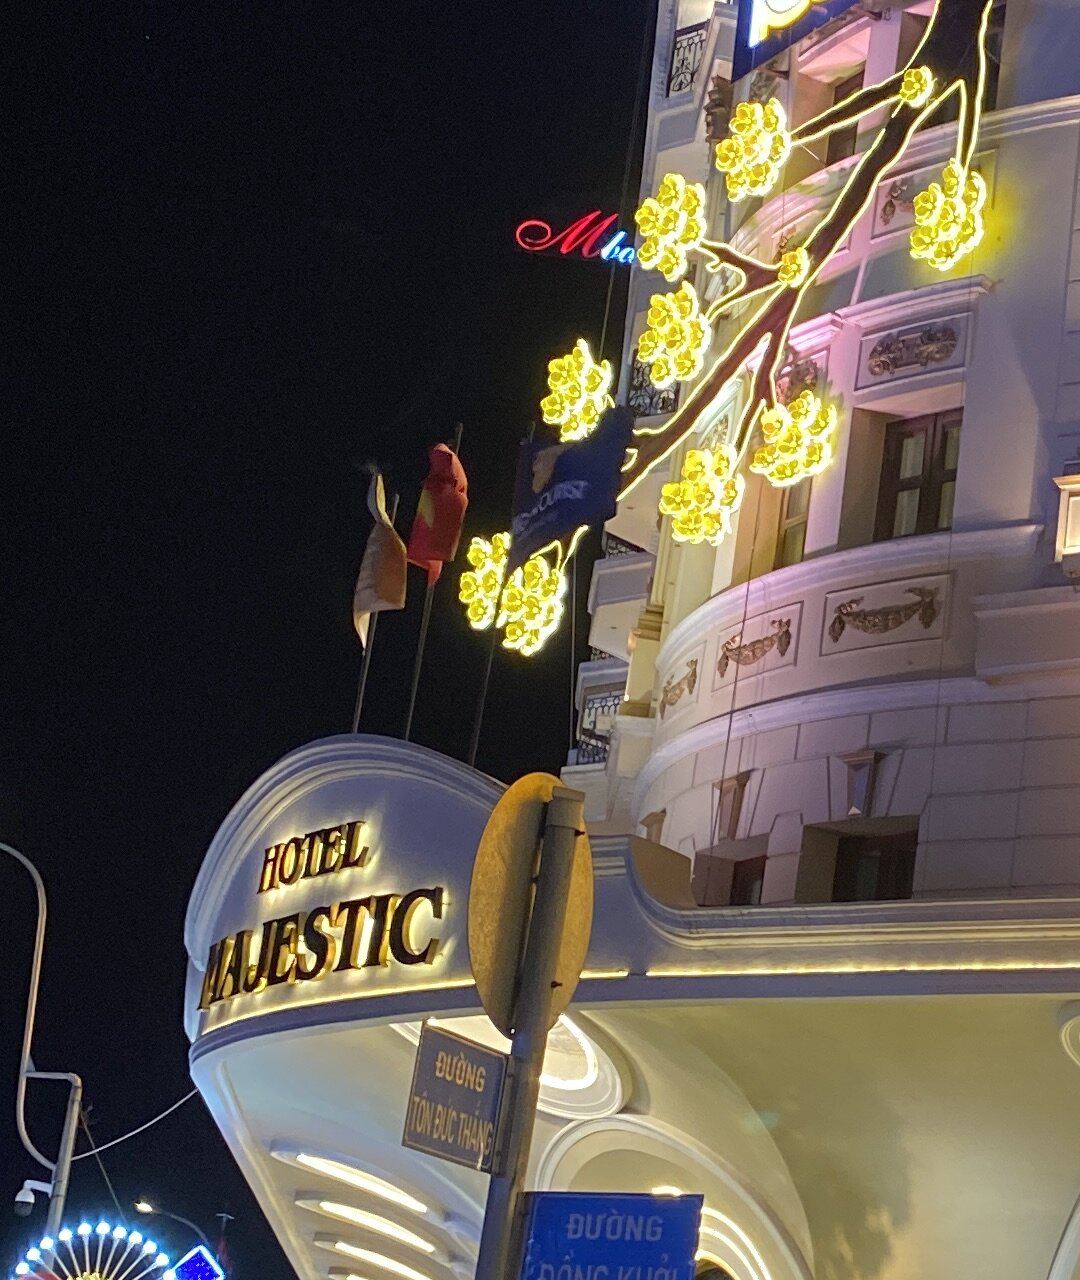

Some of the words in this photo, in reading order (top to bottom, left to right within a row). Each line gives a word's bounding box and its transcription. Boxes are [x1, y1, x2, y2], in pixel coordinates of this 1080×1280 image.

[256, 820, 371, 895] HOTEL
[197, 885, 445, 1011] MAJESTIC
[435, 1050, 486, 1093] ĐƯỜNG
[410, 1089, 434, 1137] TÔN
[432, 1098, 458, 1144] ĐỨC
[457, 1100, 494, 1156] THẮNG
[566, 1208, 663, 1242] ĐƯỜNG
